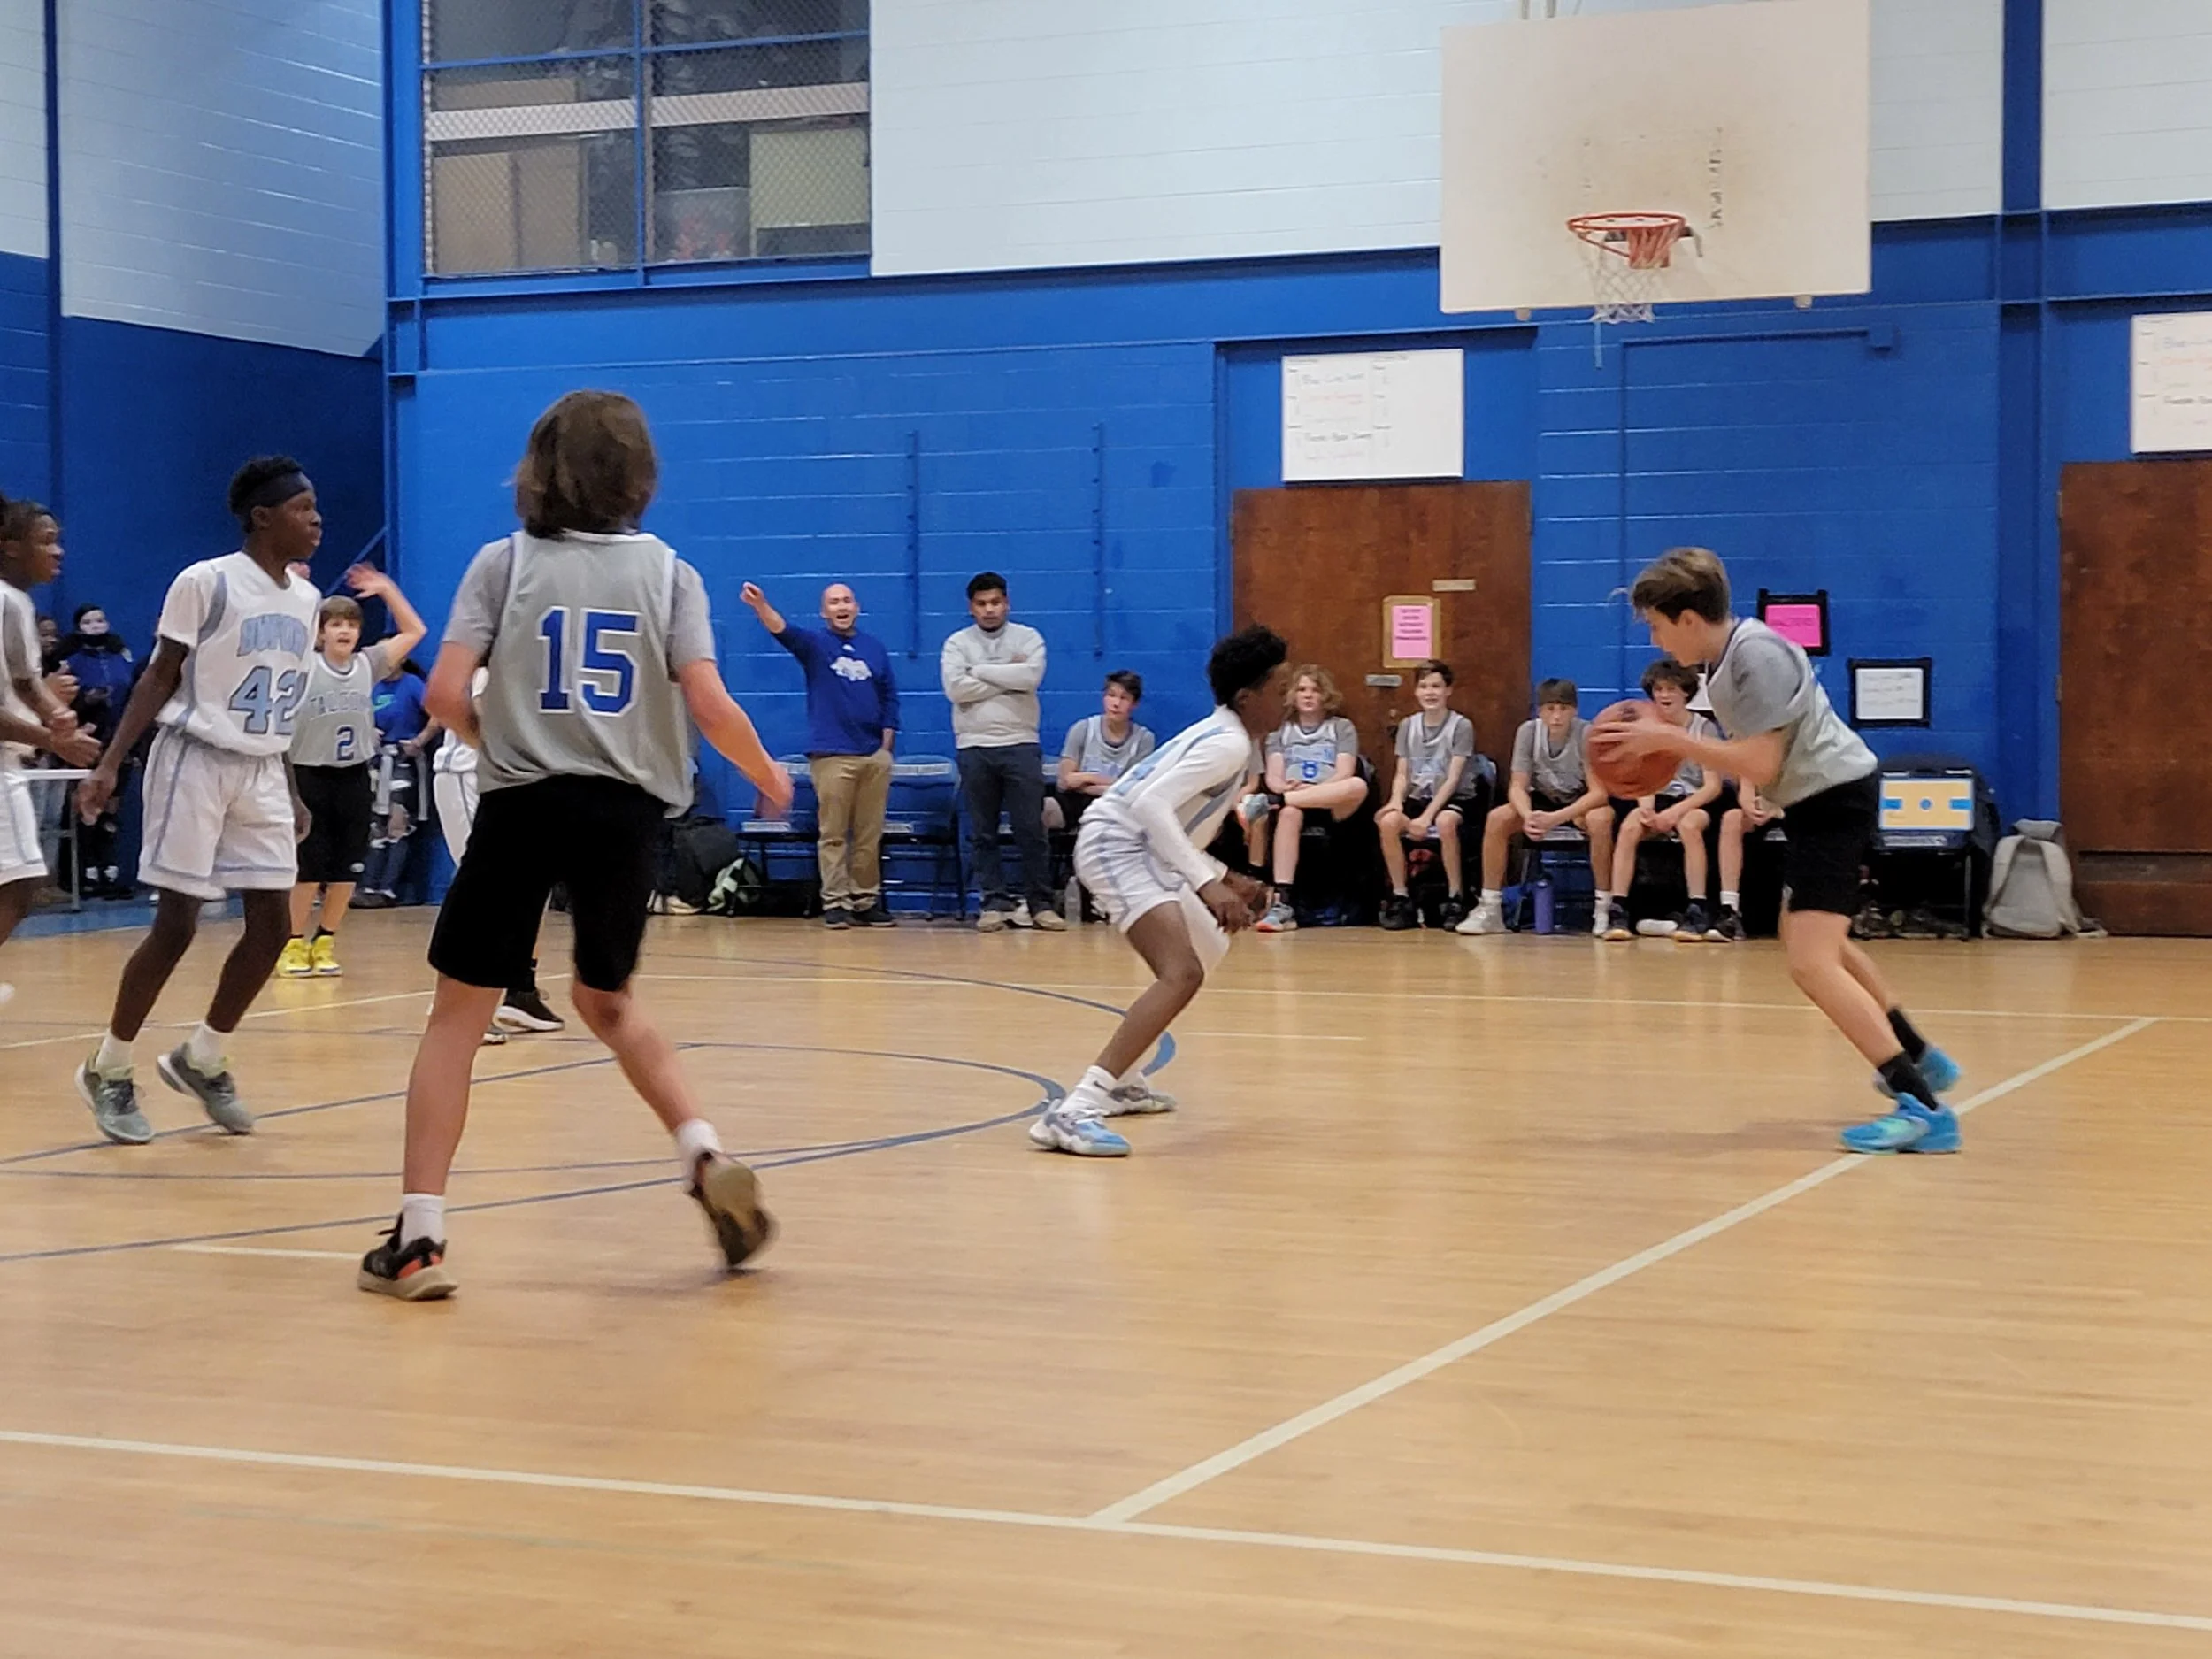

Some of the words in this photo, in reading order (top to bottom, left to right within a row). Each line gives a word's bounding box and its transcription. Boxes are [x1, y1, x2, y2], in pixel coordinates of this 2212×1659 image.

[537, 605, 645, 718] 15
[227, 665, 310, 736] 42
[336, 724, 356, 762] 2
